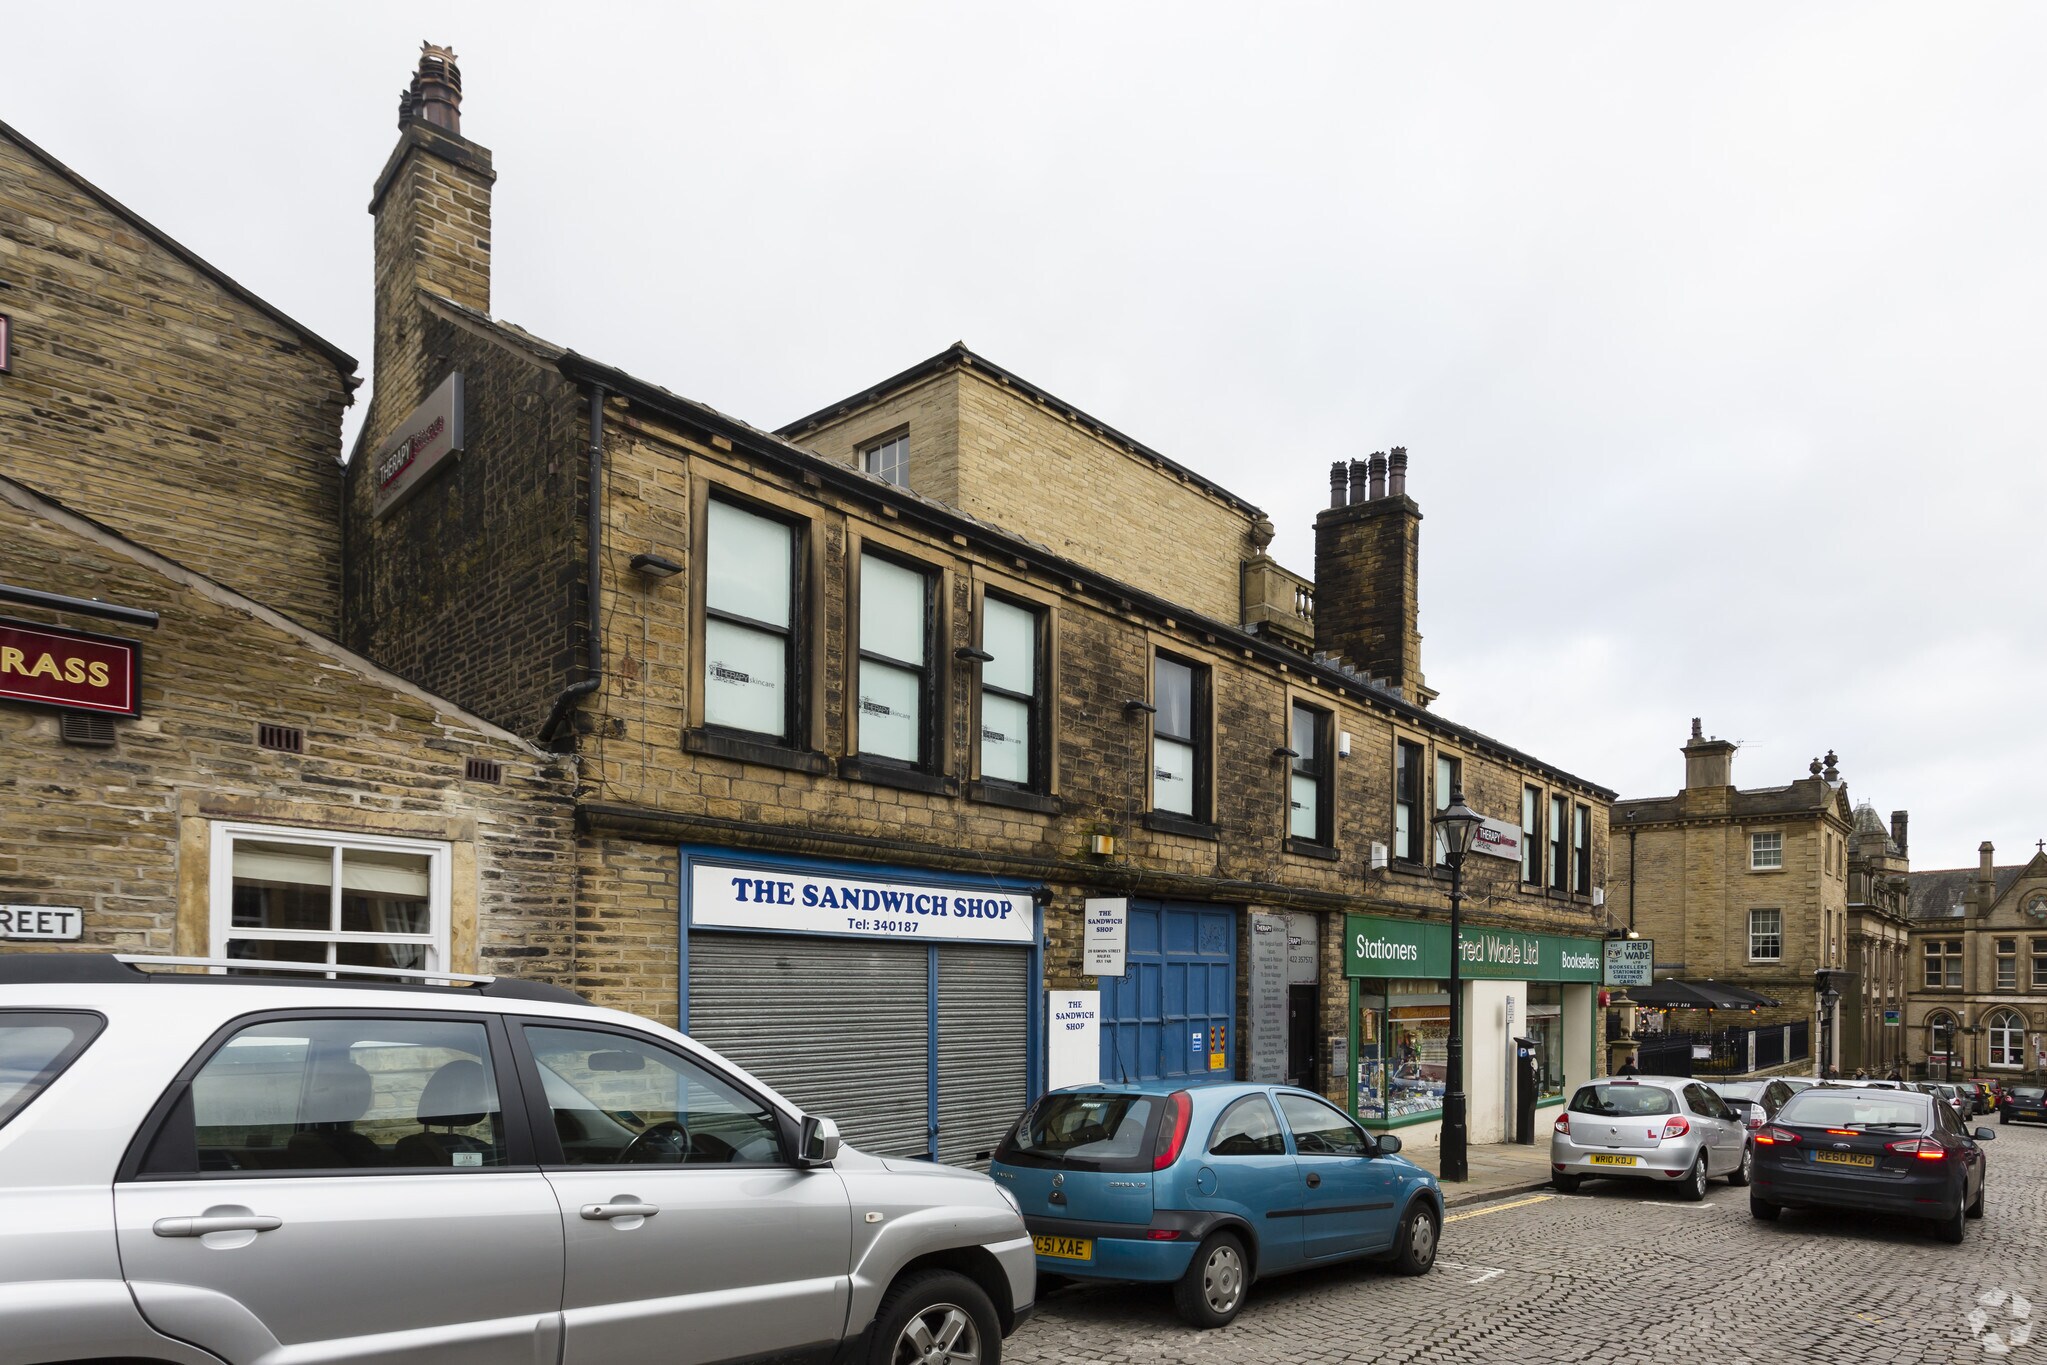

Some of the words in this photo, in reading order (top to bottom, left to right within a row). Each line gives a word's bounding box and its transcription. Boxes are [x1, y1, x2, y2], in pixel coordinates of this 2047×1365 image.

[378, 439, 412, 484] THERAPY
[1, 646, 110, 688] RASS
[717, 668, 749, 683] THERAPY
[749, 677, 775, 689] skincare
[864, 702, 890, 715] THERAPY
[890, 708, 911, 720] skincare
[1480, 828, 1500, 843] THERAPY
[732, 877, 795, 905] THE
[802, 884, 948, 917] SANDWICH
[953, 897, 1013, 920] SHOP
[848, 918, 870, 930] Tel:
[873, 919, 919, 933] 340187
[1356, 934, 1417, 962] Stationers
[1486, 934, 1521, 964] Wade
[1523, 939, 1539, 965] Ltd
[1626, 942, 1648, 950] FRED
[1562, 950, 1599, 969] Booksellers
[1624, 952, 1651, 960] WADE
[1068, 1001, 1082, 1009] THE
[1055, 1011, 1094, 1020] SANDWICH
[1065, 1023, 1085, 1031] SHOP
[1595, 1155, 1613, 1164] WR10
[1615, 1156, 1632, 1165] KDJ
[1818, 1150, 1847, 1162] RE60
[1849, 1154, 1873, 1165] MZG
[1058, 1238, 1084, 1256] XAE
